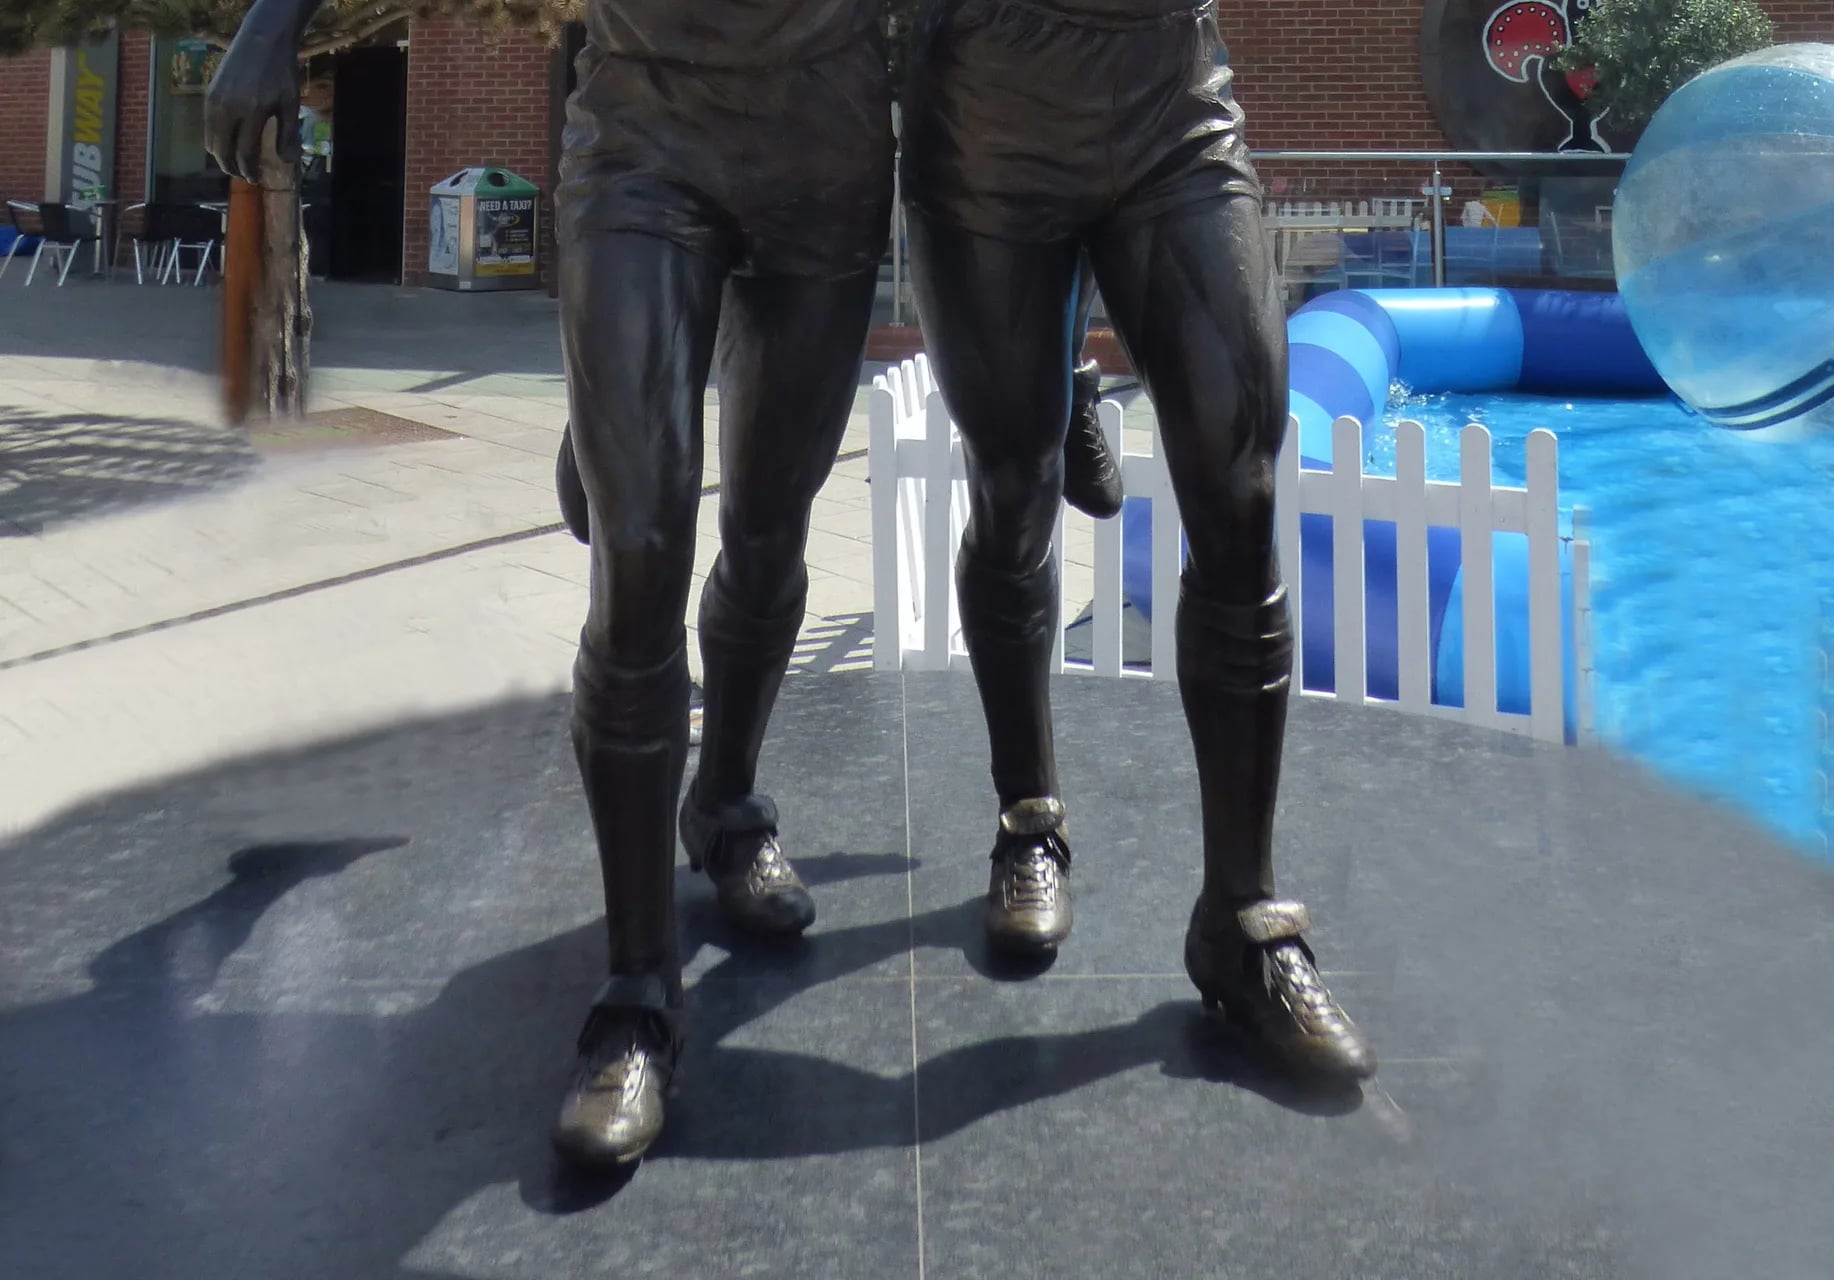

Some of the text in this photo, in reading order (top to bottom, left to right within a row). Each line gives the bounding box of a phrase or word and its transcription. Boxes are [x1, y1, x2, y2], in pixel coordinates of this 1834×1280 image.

[479, 199, 532, 211] NEED A TAXI?
